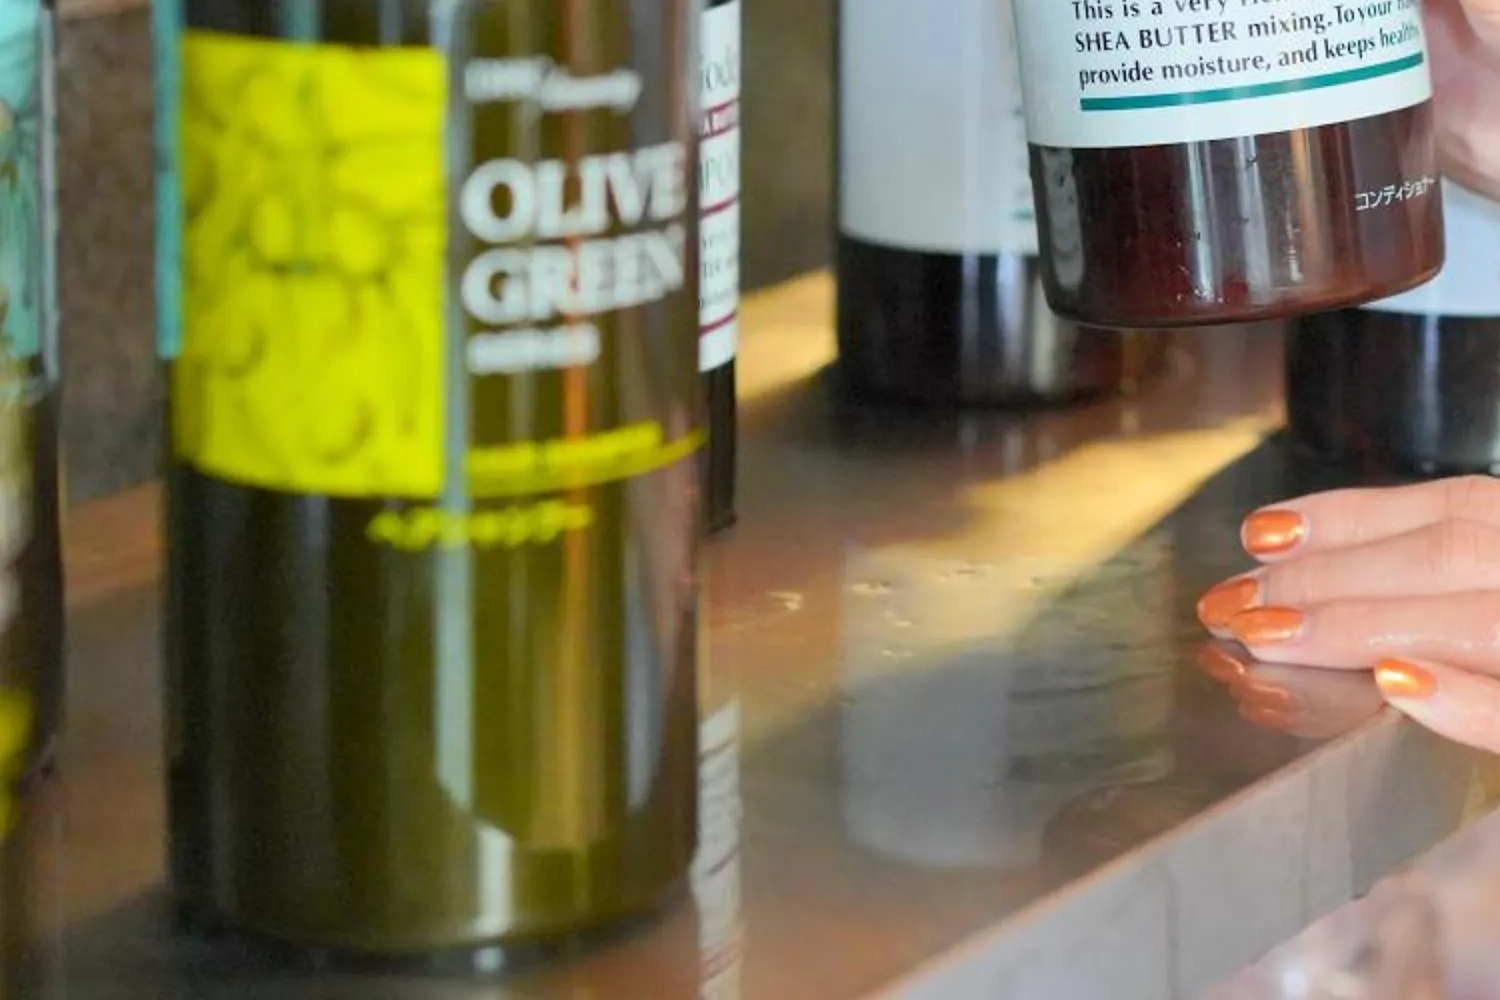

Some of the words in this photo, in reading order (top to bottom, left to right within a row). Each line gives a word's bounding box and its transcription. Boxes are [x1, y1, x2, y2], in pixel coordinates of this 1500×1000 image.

[1150, 0, 1164, 16] a
[1074, 30, 1131, 53] SHEA
[1139, 20, 1238, 50] BUTTER
[1078, 60, 1154, 91] provide
[1161, 53, 1272, 80] moisture,
[1277, 39, 1319, 67] and
[1323, 37, 1376, 60] keeps
[460, 140, 687, 244] OLIVE
[460, 222, 686, 326] GREEN
